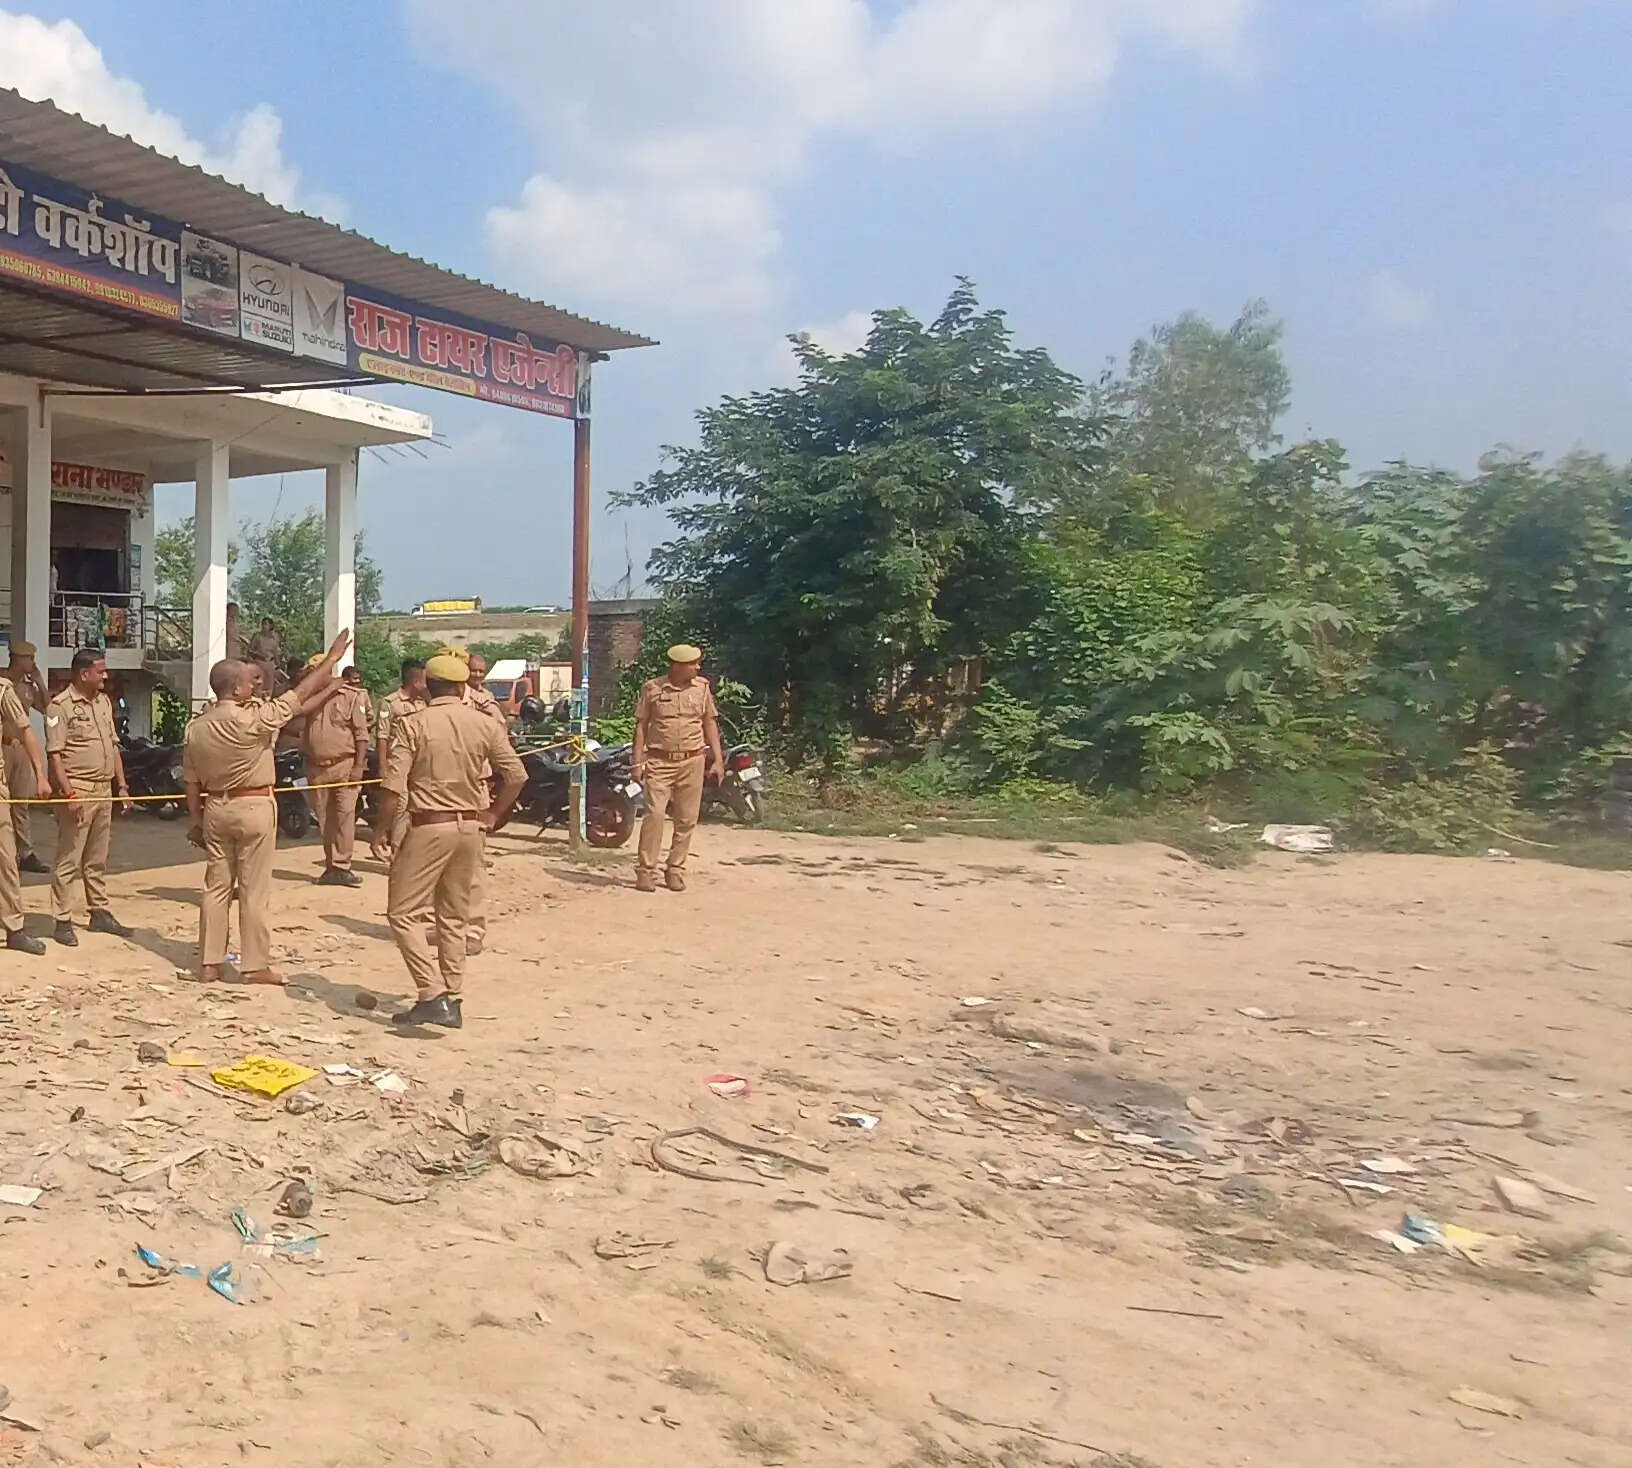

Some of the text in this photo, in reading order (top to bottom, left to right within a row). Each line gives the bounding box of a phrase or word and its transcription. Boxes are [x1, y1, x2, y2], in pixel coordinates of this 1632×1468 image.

[32, 193, 180, 284] वर्कशॉप
[242, 292, 290, 317] HYUNDAI
[261, 321, 292, 337] MARUTI
[262, 330, 293, 345] SUZUKI
[346, 296, 412, 360] राज
[415, 316, 490, 377] टायर
[301, 332, 346, 353] mahindra
